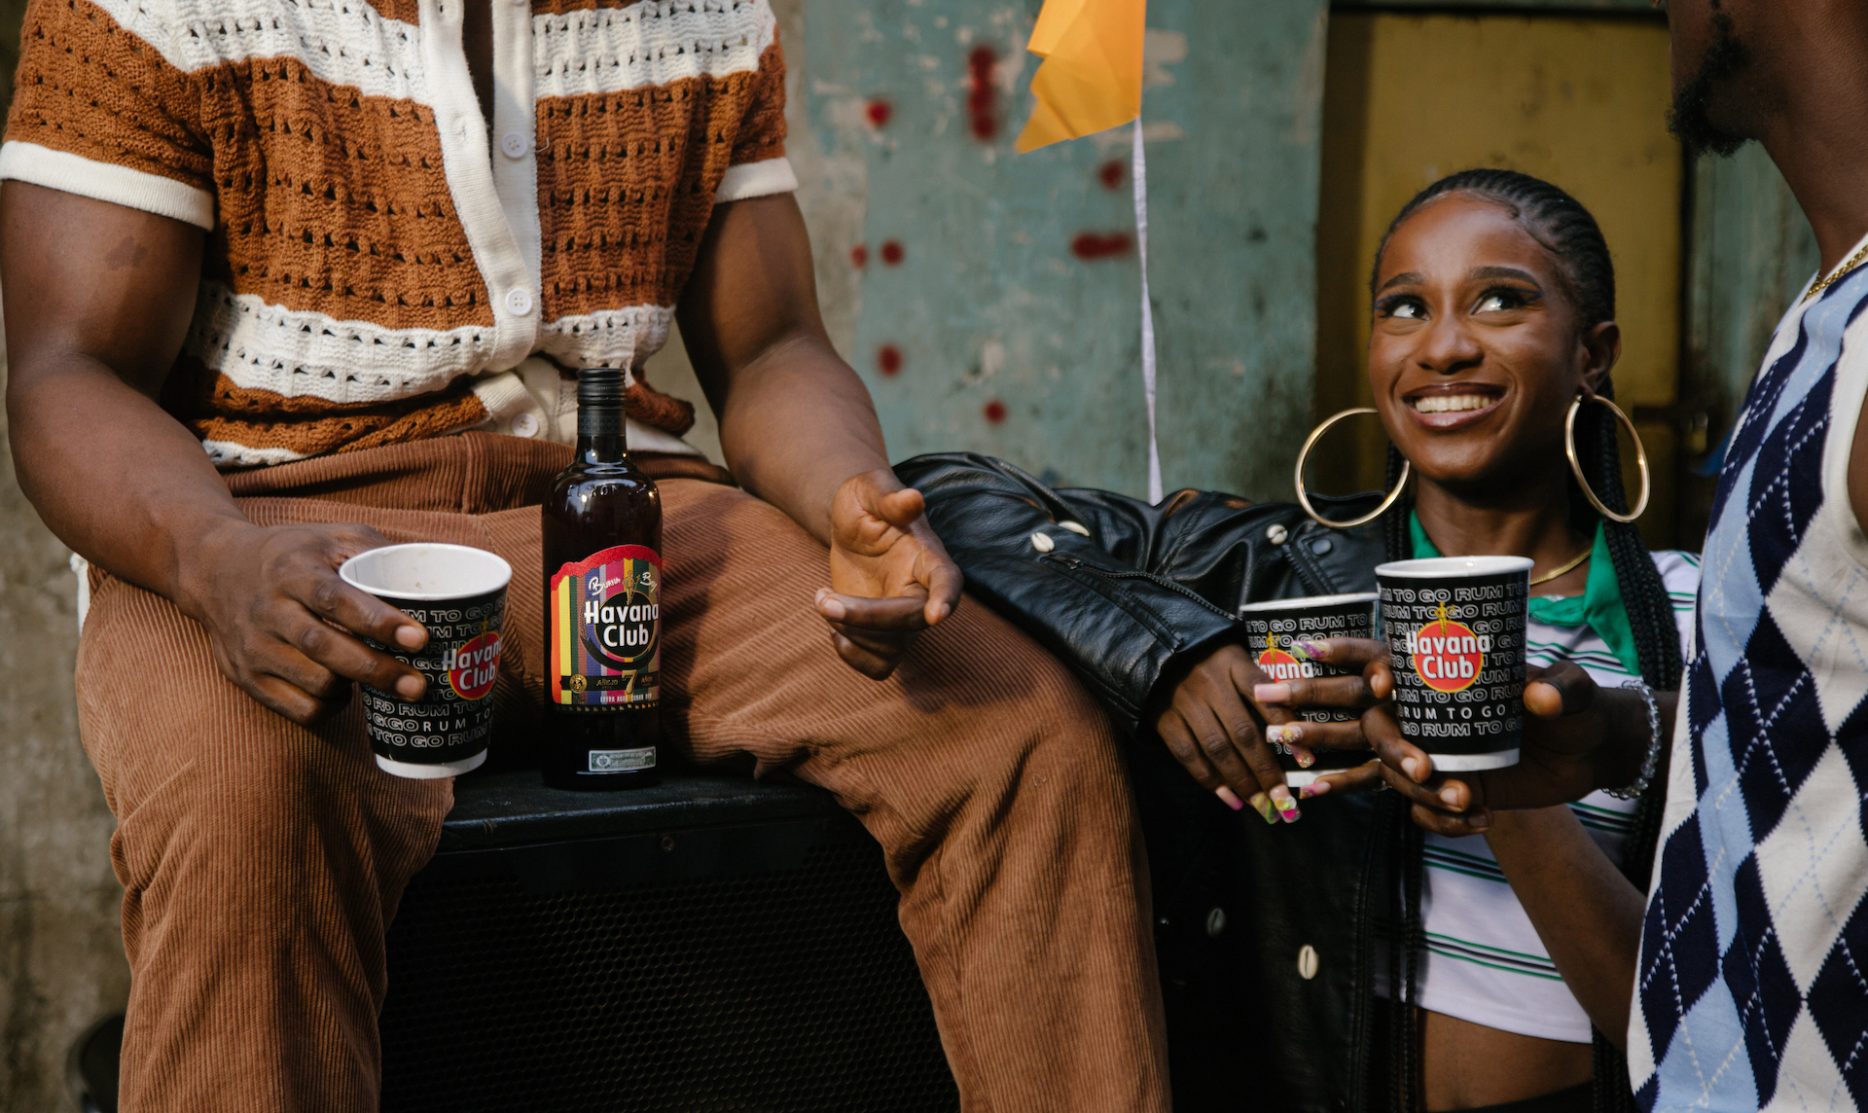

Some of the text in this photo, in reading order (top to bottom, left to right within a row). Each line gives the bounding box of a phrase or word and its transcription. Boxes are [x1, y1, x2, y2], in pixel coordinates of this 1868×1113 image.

[1393, 588, 1416, 603] TO
[1418, 588, 1451, 603] GO
[1454, 585, 1503, 601] RUM
[430, 609, 462, 624] TO
[584, 600, 659, 625] Havana
[1269, 618, 1297, 632] GO
[1299, 615, 1345, 631] RUM
[603, 623, 650, 647] Club
[1406, 631, 1491, 655] Havana
[442, 639, 501, 672] Havan
[1258, 661, 1315, 680] vana
[1422, 655, 1475, 679] Club
[459, 664, 496, 690] Club
[621, 669, 639, 694] 7
[1474, 668, 1511, 685] UM
[1399, 688, 1420, 703] UM
[1421, 690, 1450, 704] TO
[1454, 686, 1488, 702] GO
[398, 701, 450, 717] RUM
[1404, 706, 1438, 720] RUM
[1446, 707, 1473, 720] TO
[1481, 704, 1506, 718] GO
[422, 718, 467, 733] RUM
[1421, 722, 1472, 737] RUM
[1474, 720, 1503, 736] TO
[410, 734, 445, 748] GO
